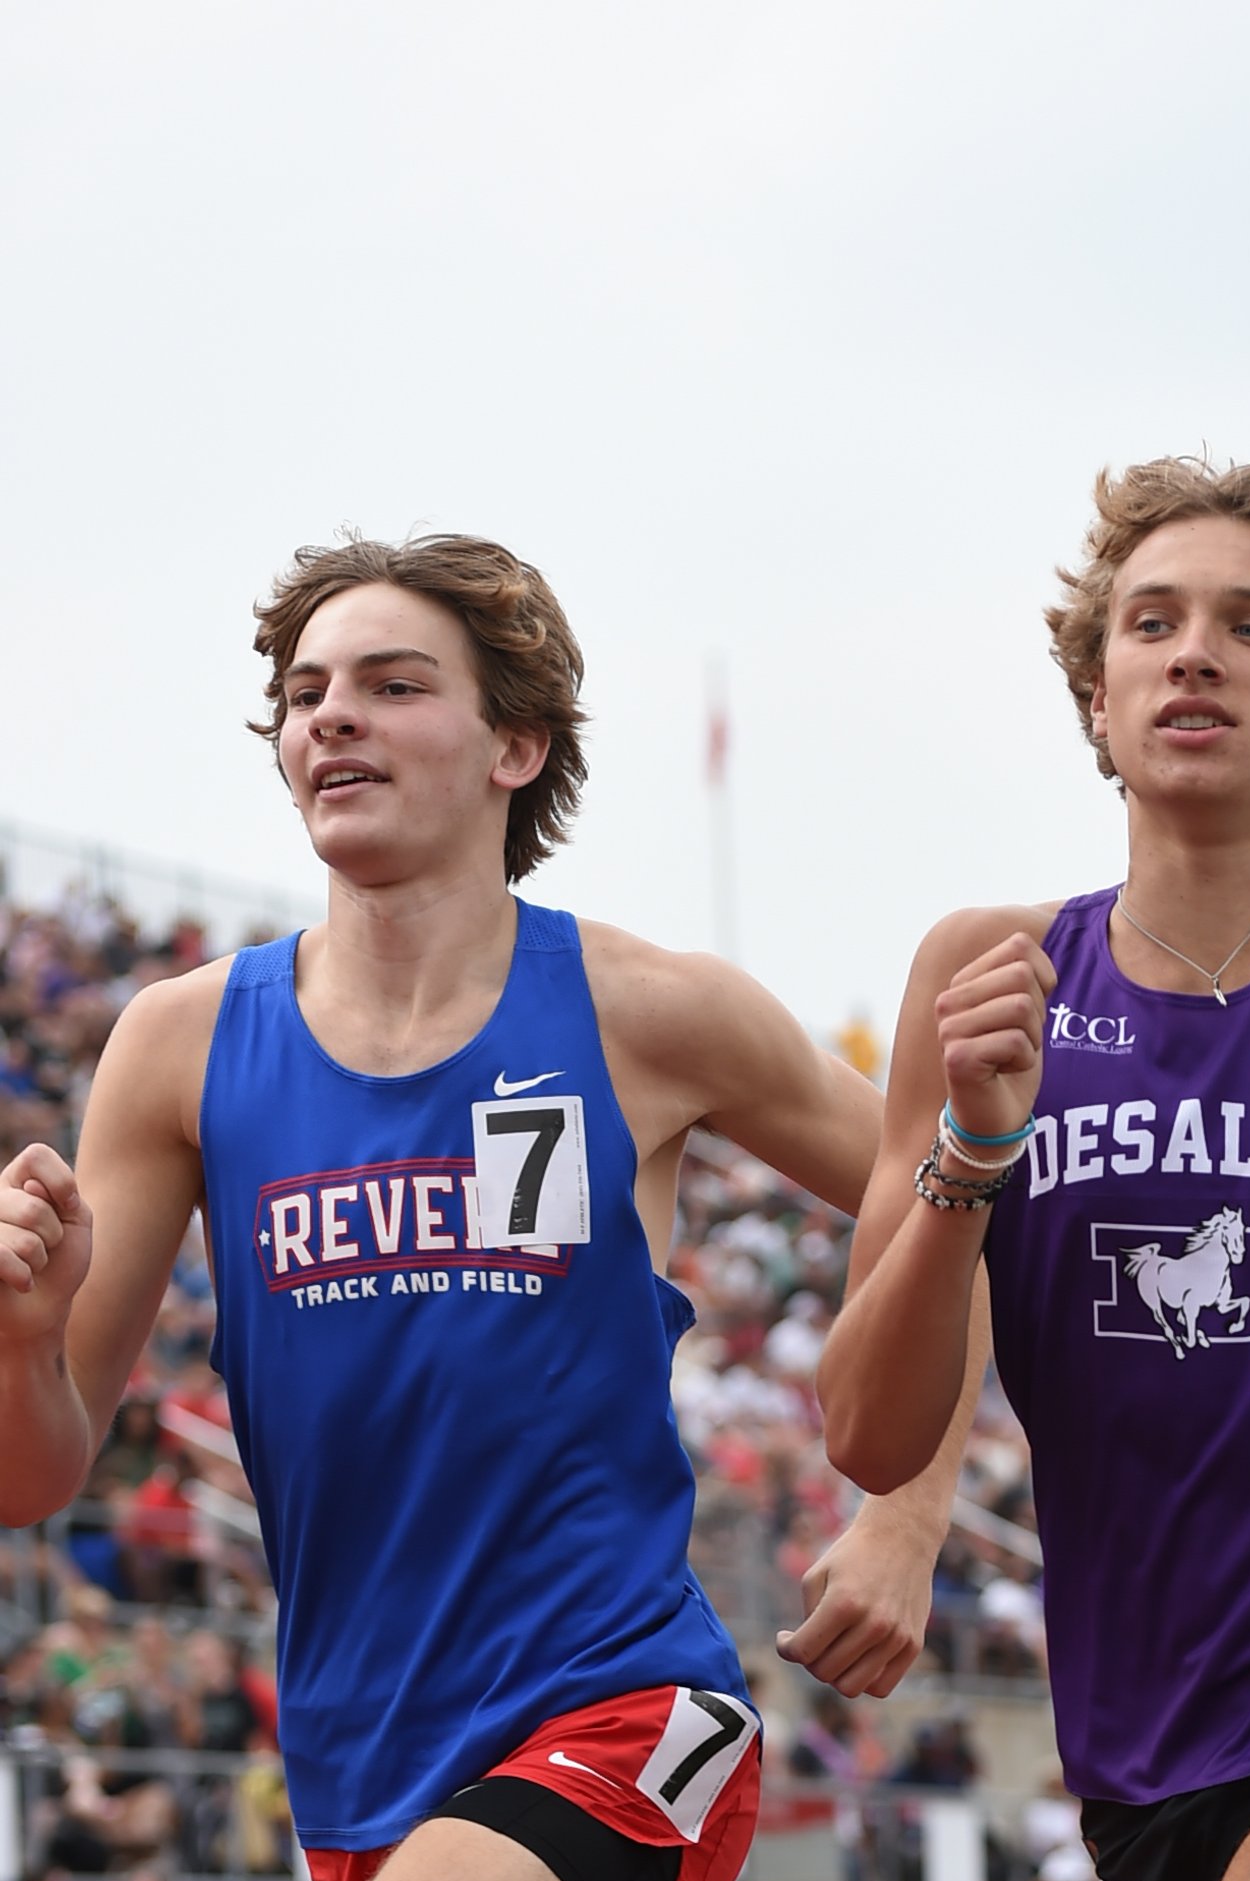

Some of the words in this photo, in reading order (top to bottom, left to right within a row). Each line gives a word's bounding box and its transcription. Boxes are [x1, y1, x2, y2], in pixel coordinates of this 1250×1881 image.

[485, 1108, 565, 1235] 7
[270, 1176, 559, 1275] REVE
[291, 1276, 379, 1309] TRACK
[390, 1271, 450, 1294] AND
[462, 1270, 542, 1296] FIELD
[658, 1690, 747, 1806] 7
